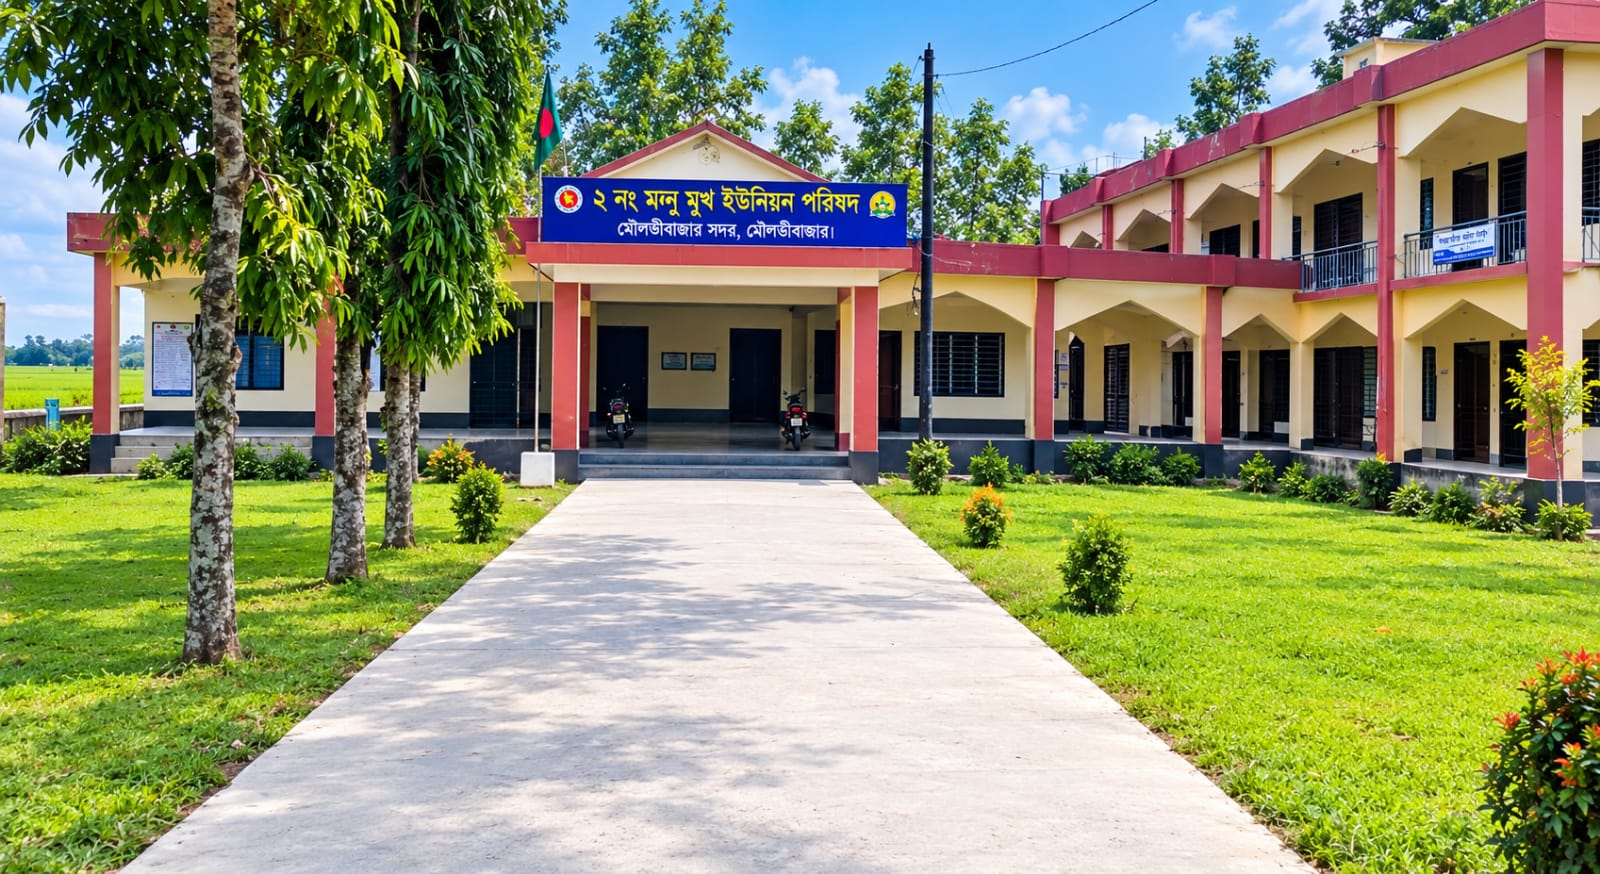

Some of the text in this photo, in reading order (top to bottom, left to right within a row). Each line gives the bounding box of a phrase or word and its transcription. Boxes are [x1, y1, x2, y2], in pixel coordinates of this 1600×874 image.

[593, 189, 608, 212] ২
[612, 189, 639, 213] নং
[684, 188, 716, 217] মুখ
[720, 185, 796, 214] ইউনিয়ন
[801, 186, 861, 214] পরিষদ
[617, 217, 703, 237] মৌলভীবাজার
[707, 223, 741, 241] সদর,
